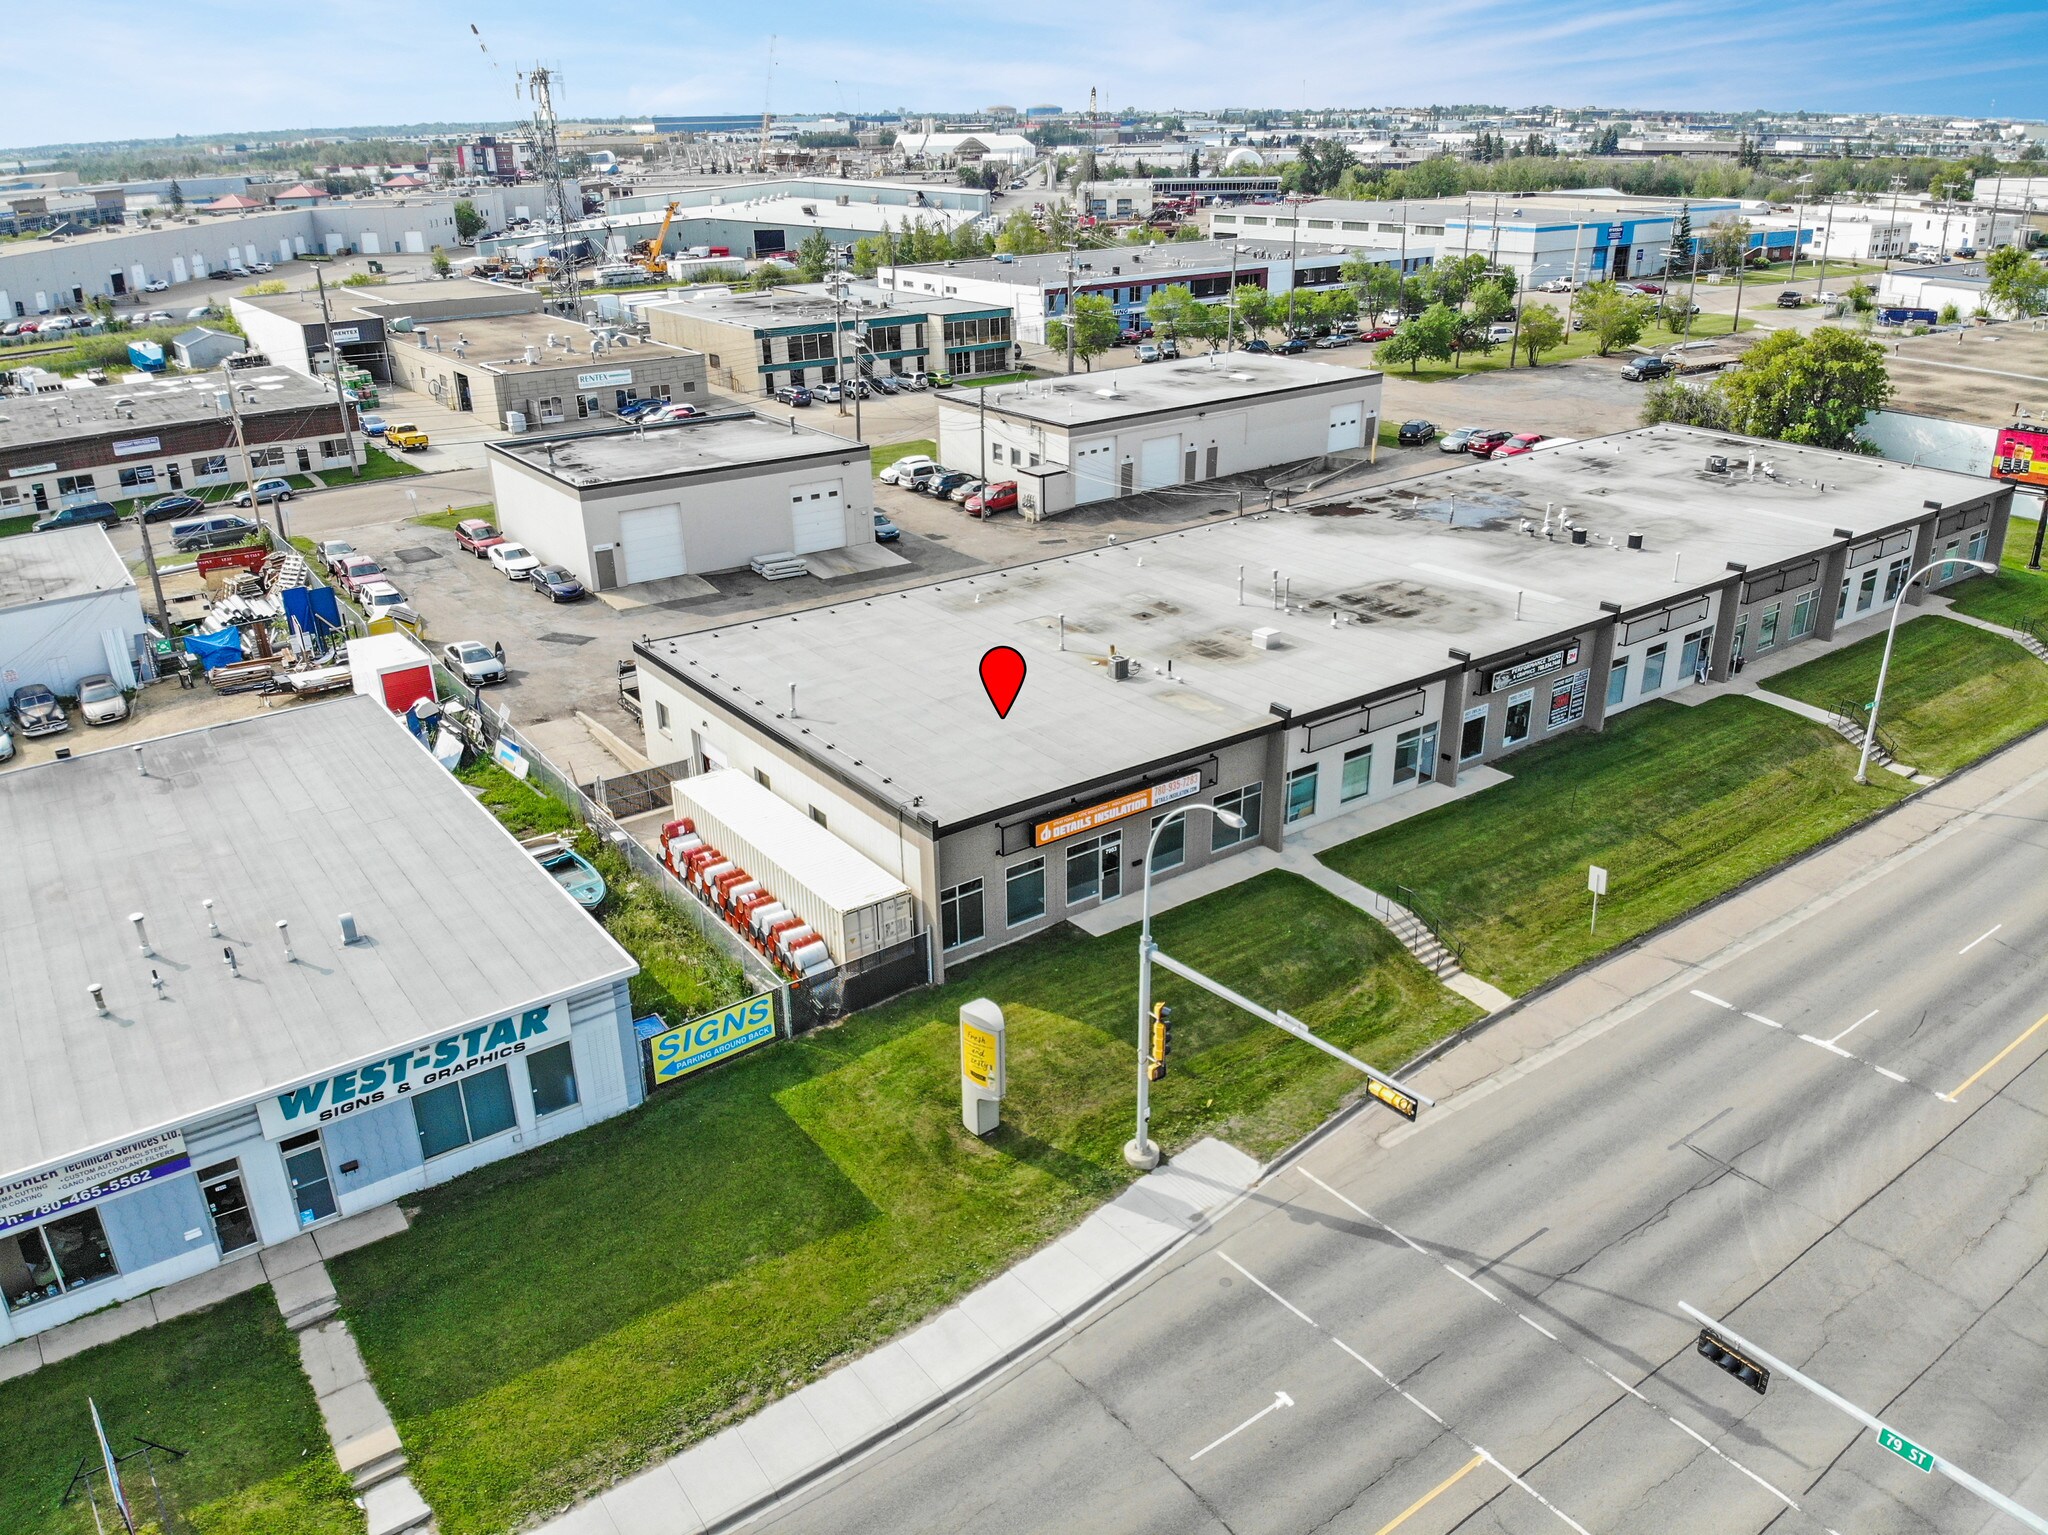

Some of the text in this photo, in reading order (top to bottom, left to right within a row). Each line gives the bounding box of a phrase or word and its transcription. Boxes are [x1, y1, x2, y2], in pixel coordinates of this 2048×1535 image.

[580, 373, 608, 383] RENTEX
[1511, 659, 1546, 674] PERFORMANCE
[1548, 653, 1561, 662] SIGNS
[1552, 693, 1570, 709] 3M
[1154, 774, 1198, 796] 780-935-7283
[1053, 797, 1147, 838] DETAILS INSULATION
[657, 998, 769, 1061] SIGNS
[276, 1005, 551, 1121] WEST-STAR
[676, 1027, 770, 1070] PARKING AROUND BACK
[319, 1041, 526, 1121] SIGNS & GRAPHICS
[116, 1136, 159, 1156] Services
[161, 1130, 181, 1141] Ltd.
[62, 1149, 175, 1190] GANO AUTO COOLANT FILTERS
[64, 1144, 169, 1181] CUSTOM AUTO UPHOLSTERY
[9, 1192, 43, 1207] COATING
[15, 1183, 48, 1198] CUTTING
[29, 1169, 152, 1217] 780-465-5562
[1886, 1433, 1927, 1465] 79 ST
